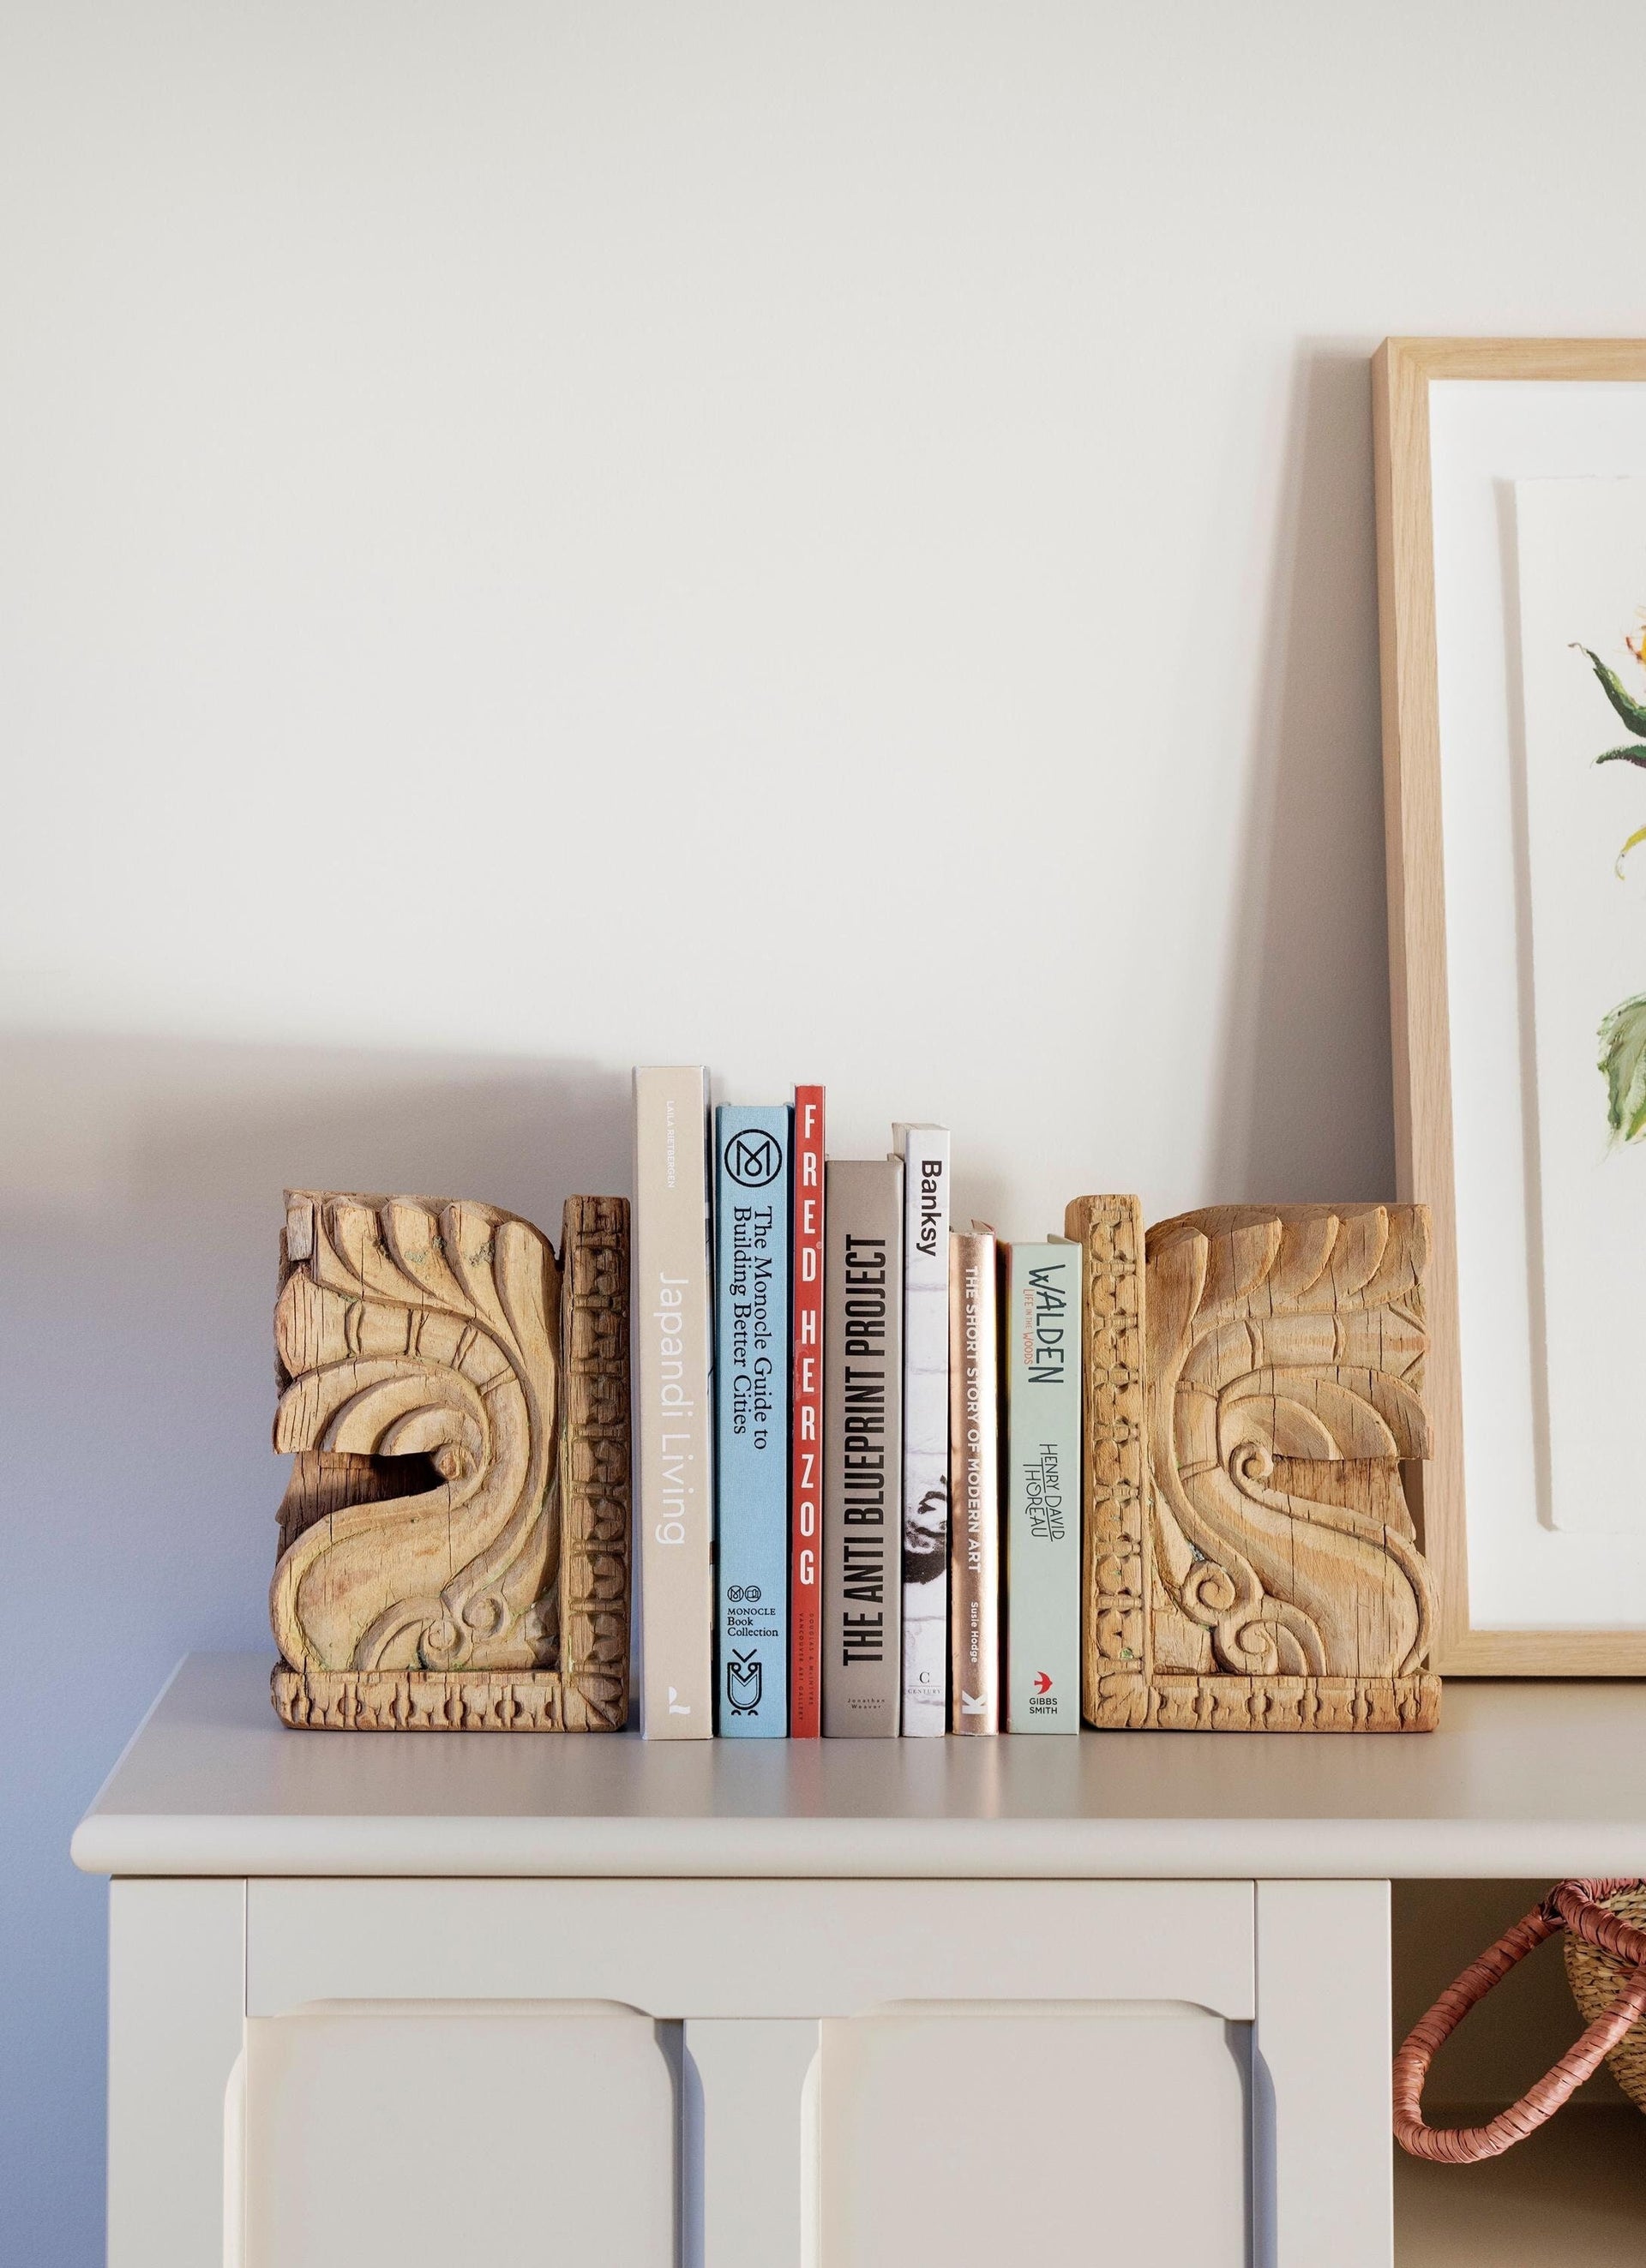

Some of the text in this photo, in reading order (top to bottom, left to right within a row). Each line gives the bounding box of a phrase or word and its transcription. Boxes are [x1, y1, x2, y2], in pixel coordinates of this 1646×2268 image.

[916, 1161, 942, 1257] Banksy
[730, 1207, 752, 1434] Building Better Cities
[754, 1206, 772, 1449] The Monocle Guide to
[800, 1104, 818, 1586] FRED HERZOG
[1024, 1289, 1035, 1306] LIFE
[1029, 1264, 1066, 1383] WALDEN
[1023, 1332, 1034, 1365] WOODS
[654, 1272, 694, 1545] Japandi Living
[843, 1234, 886, 1666] THE ANTI BLUEPRINT PROJECT
[965, 1266, 981, 1572] THE SHORT STORY OF MODERN ART
[1023, 1464, 1048, 1537] THOREAU
[1039, 1443, 1065, 1539] HENRY DAVID
[727, 1617, 754, 1626] Book
[727, 1627, 778, 1637] Collection
[970, 1602, 979, 1663] Susie Hodge
[919, 1671, 930, 1684] C
[1029, 1697, 1058, 1706] GIBBS
